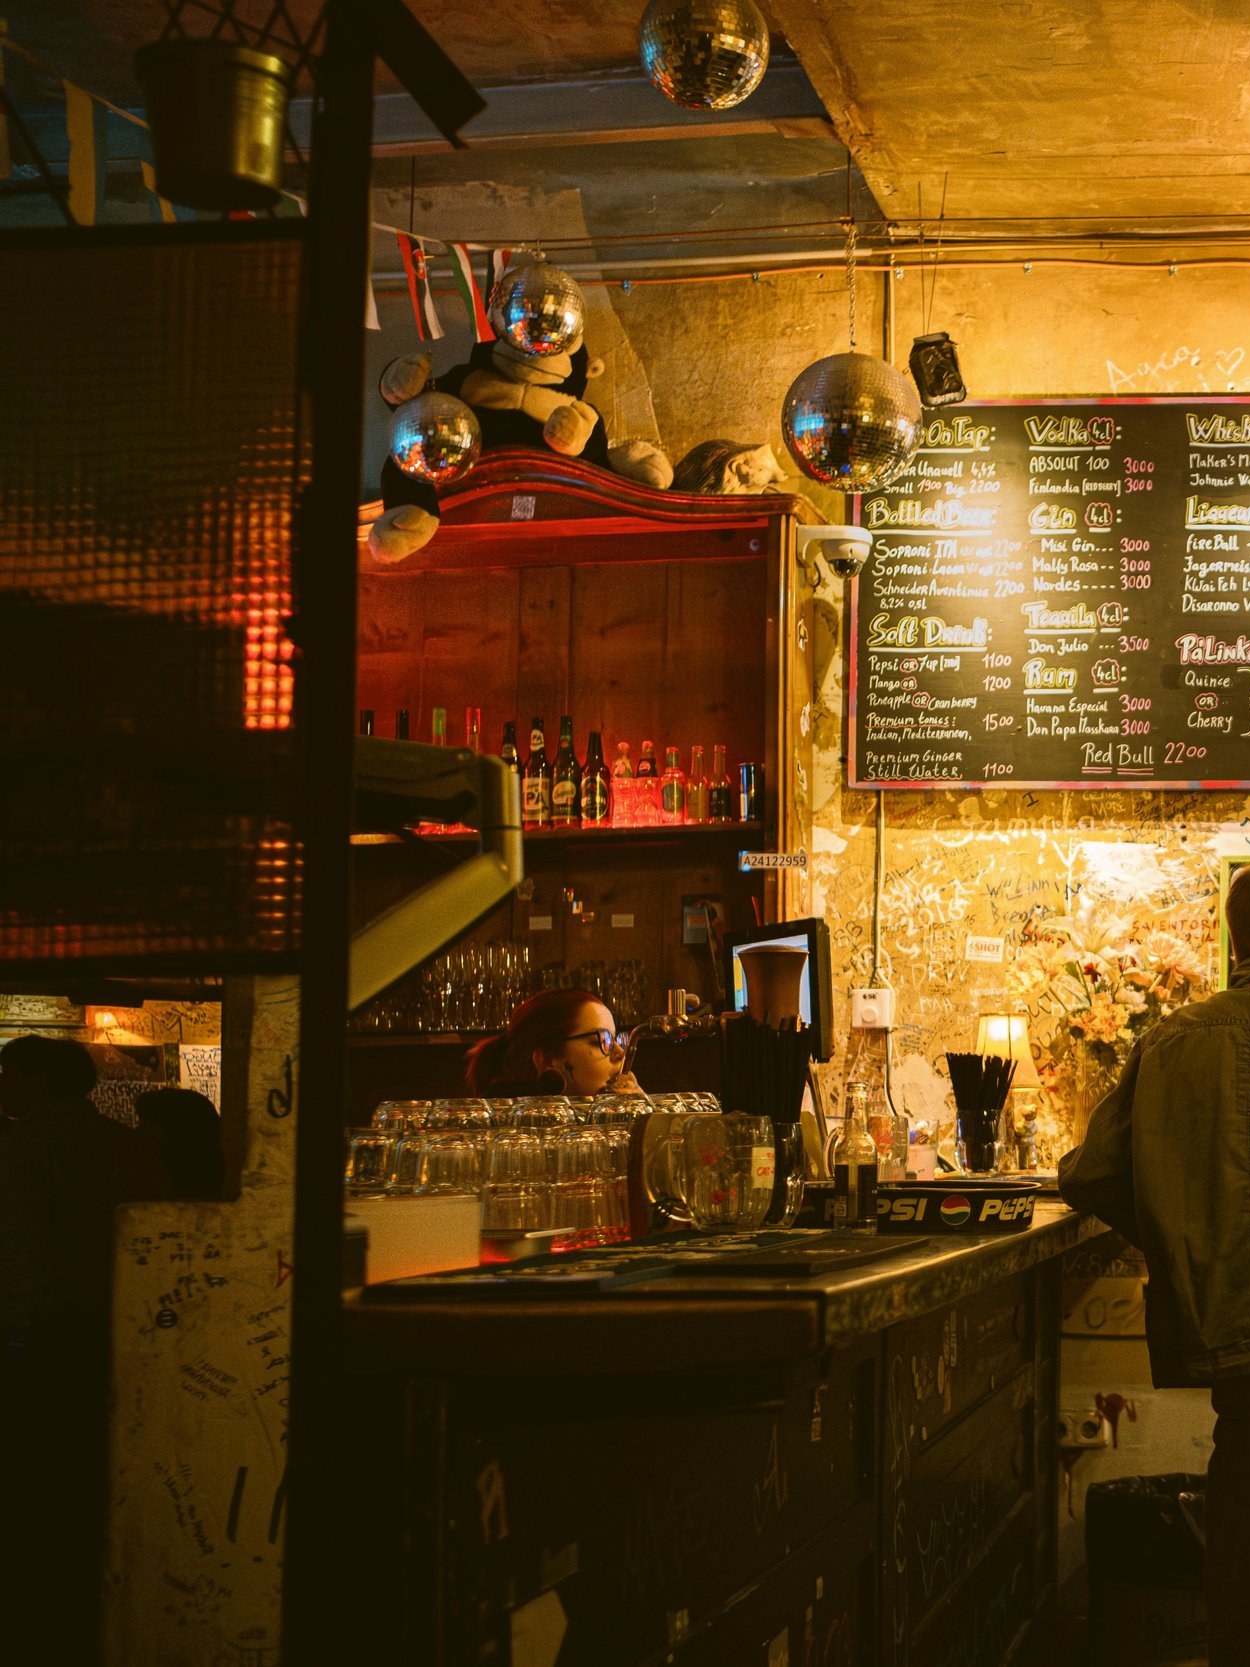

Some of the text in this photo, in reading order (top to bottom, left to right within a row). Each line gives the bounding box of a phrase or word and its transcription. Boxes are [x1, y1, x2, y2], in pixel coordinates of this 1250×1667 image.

[1029, 455, 1155, 474] ABSOLUT 100 3000
[969, 479, 1000, 493] 2200
[1124, 477, 1153, 494] 3000
[1120, 537, 1151, 553] 3000
[1119, 556, 1151, 572] 3000
[1120, 574, 1151, 590] 3000
[867, 612, 919, 648] Soft
[1028, 638, 1055, 655] Don
[1117, 635, 1150, 653] 3500
[868, 654, 900, 674] Pepsi
[982, 652, 1012, 669] 1100
[869, 675, 900, 691] Mango
[982, 676, 1012, 691] 1200
[1119, 694, 1152, 711] 3000
[982, 713, 1014, 731] 1500
[1120, 718, 1150, 736] 3000
[1081, 741, 1207, 766] Red Bull 2200
[868, 764, 901, 778] Still
[982, 763, 1014, 778] 1100
[743, 855, 807, 868] A24122959
[978, 1195, 1036, 1222] PEPS
